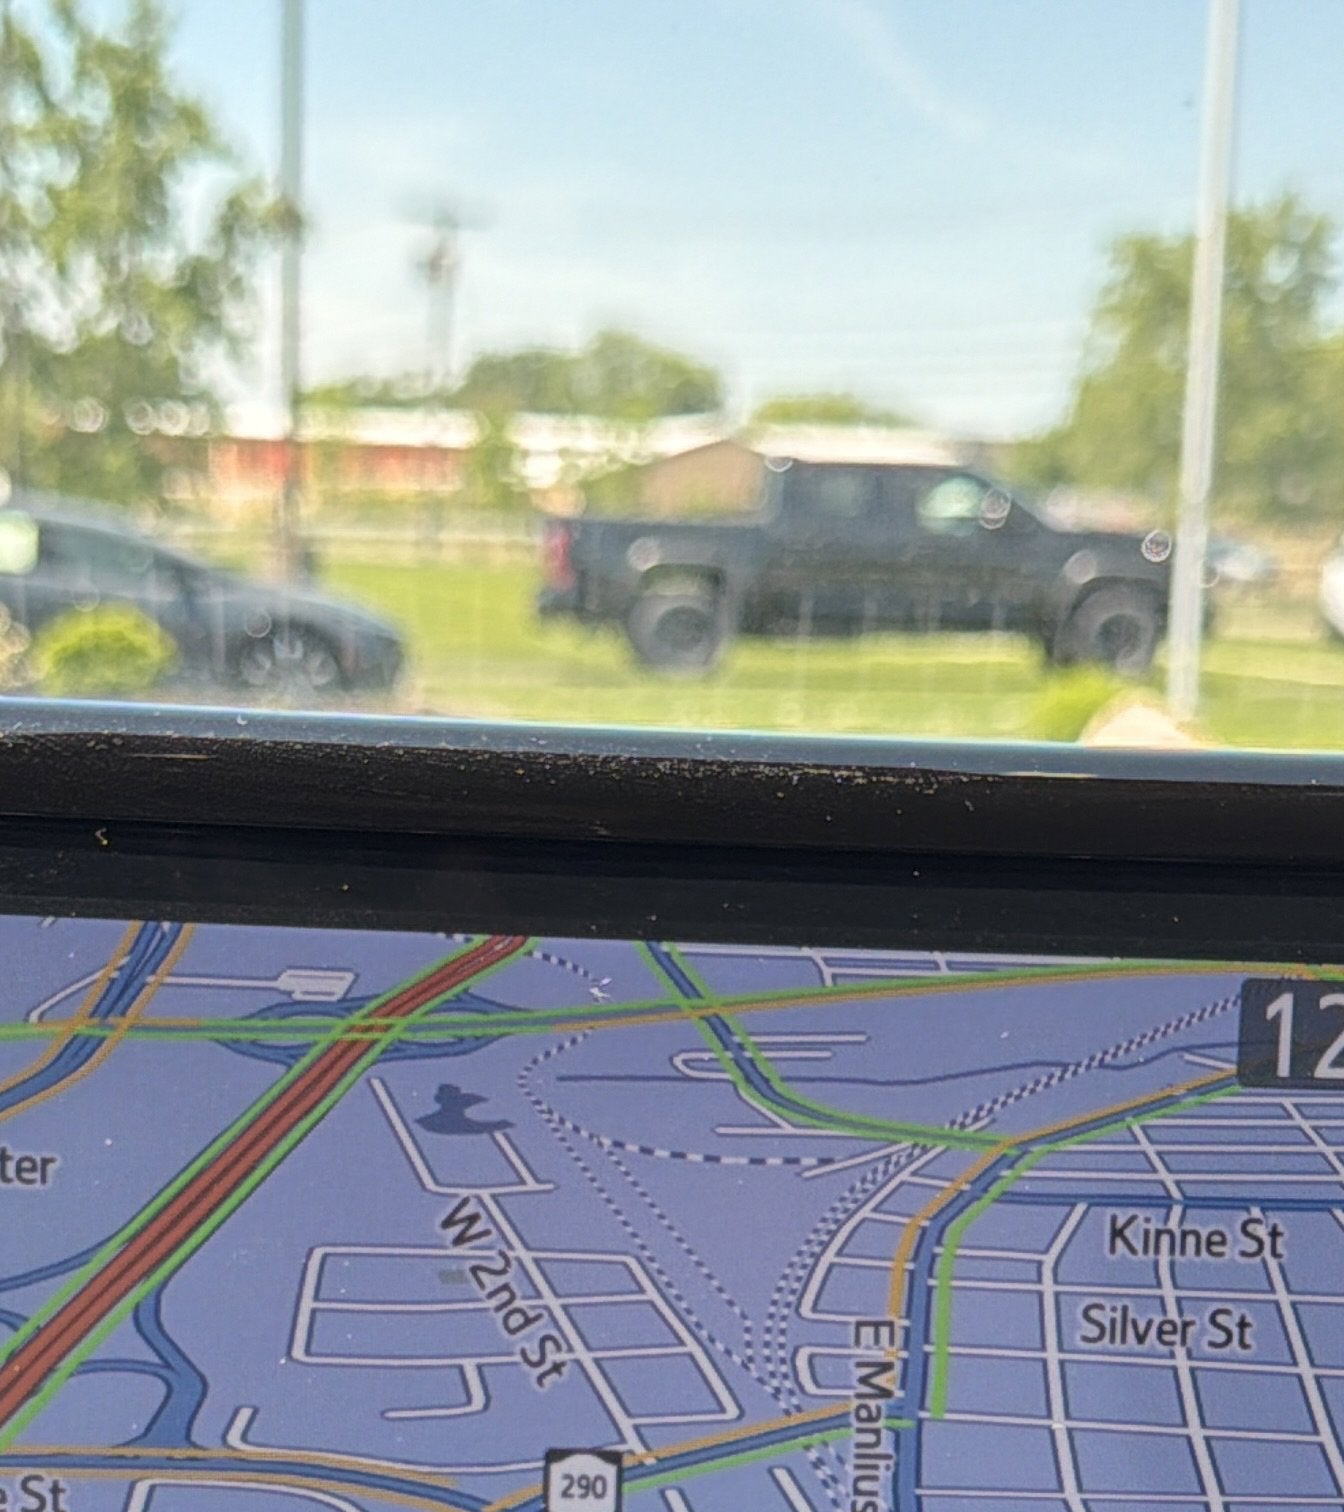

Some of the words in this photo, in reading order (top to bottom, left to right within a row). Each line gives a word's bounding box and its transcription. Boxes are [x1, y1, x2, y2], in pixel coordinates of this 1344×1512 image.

[1108, 1214, 1227, 1259] Kinne
[1240, 1220, 1286, 1261] St
[440, 1196, 492, 1249] W
[469, 1251, 539, 1338] 2nd
[521, 1335, 568, 1387] St
[856, 1320, 895, 1349] E
[1079, 1304, 1193, 1349] Silver
[1208, 1310, 1254, 1352] St
[560, 1474, 607, 1500] 290
